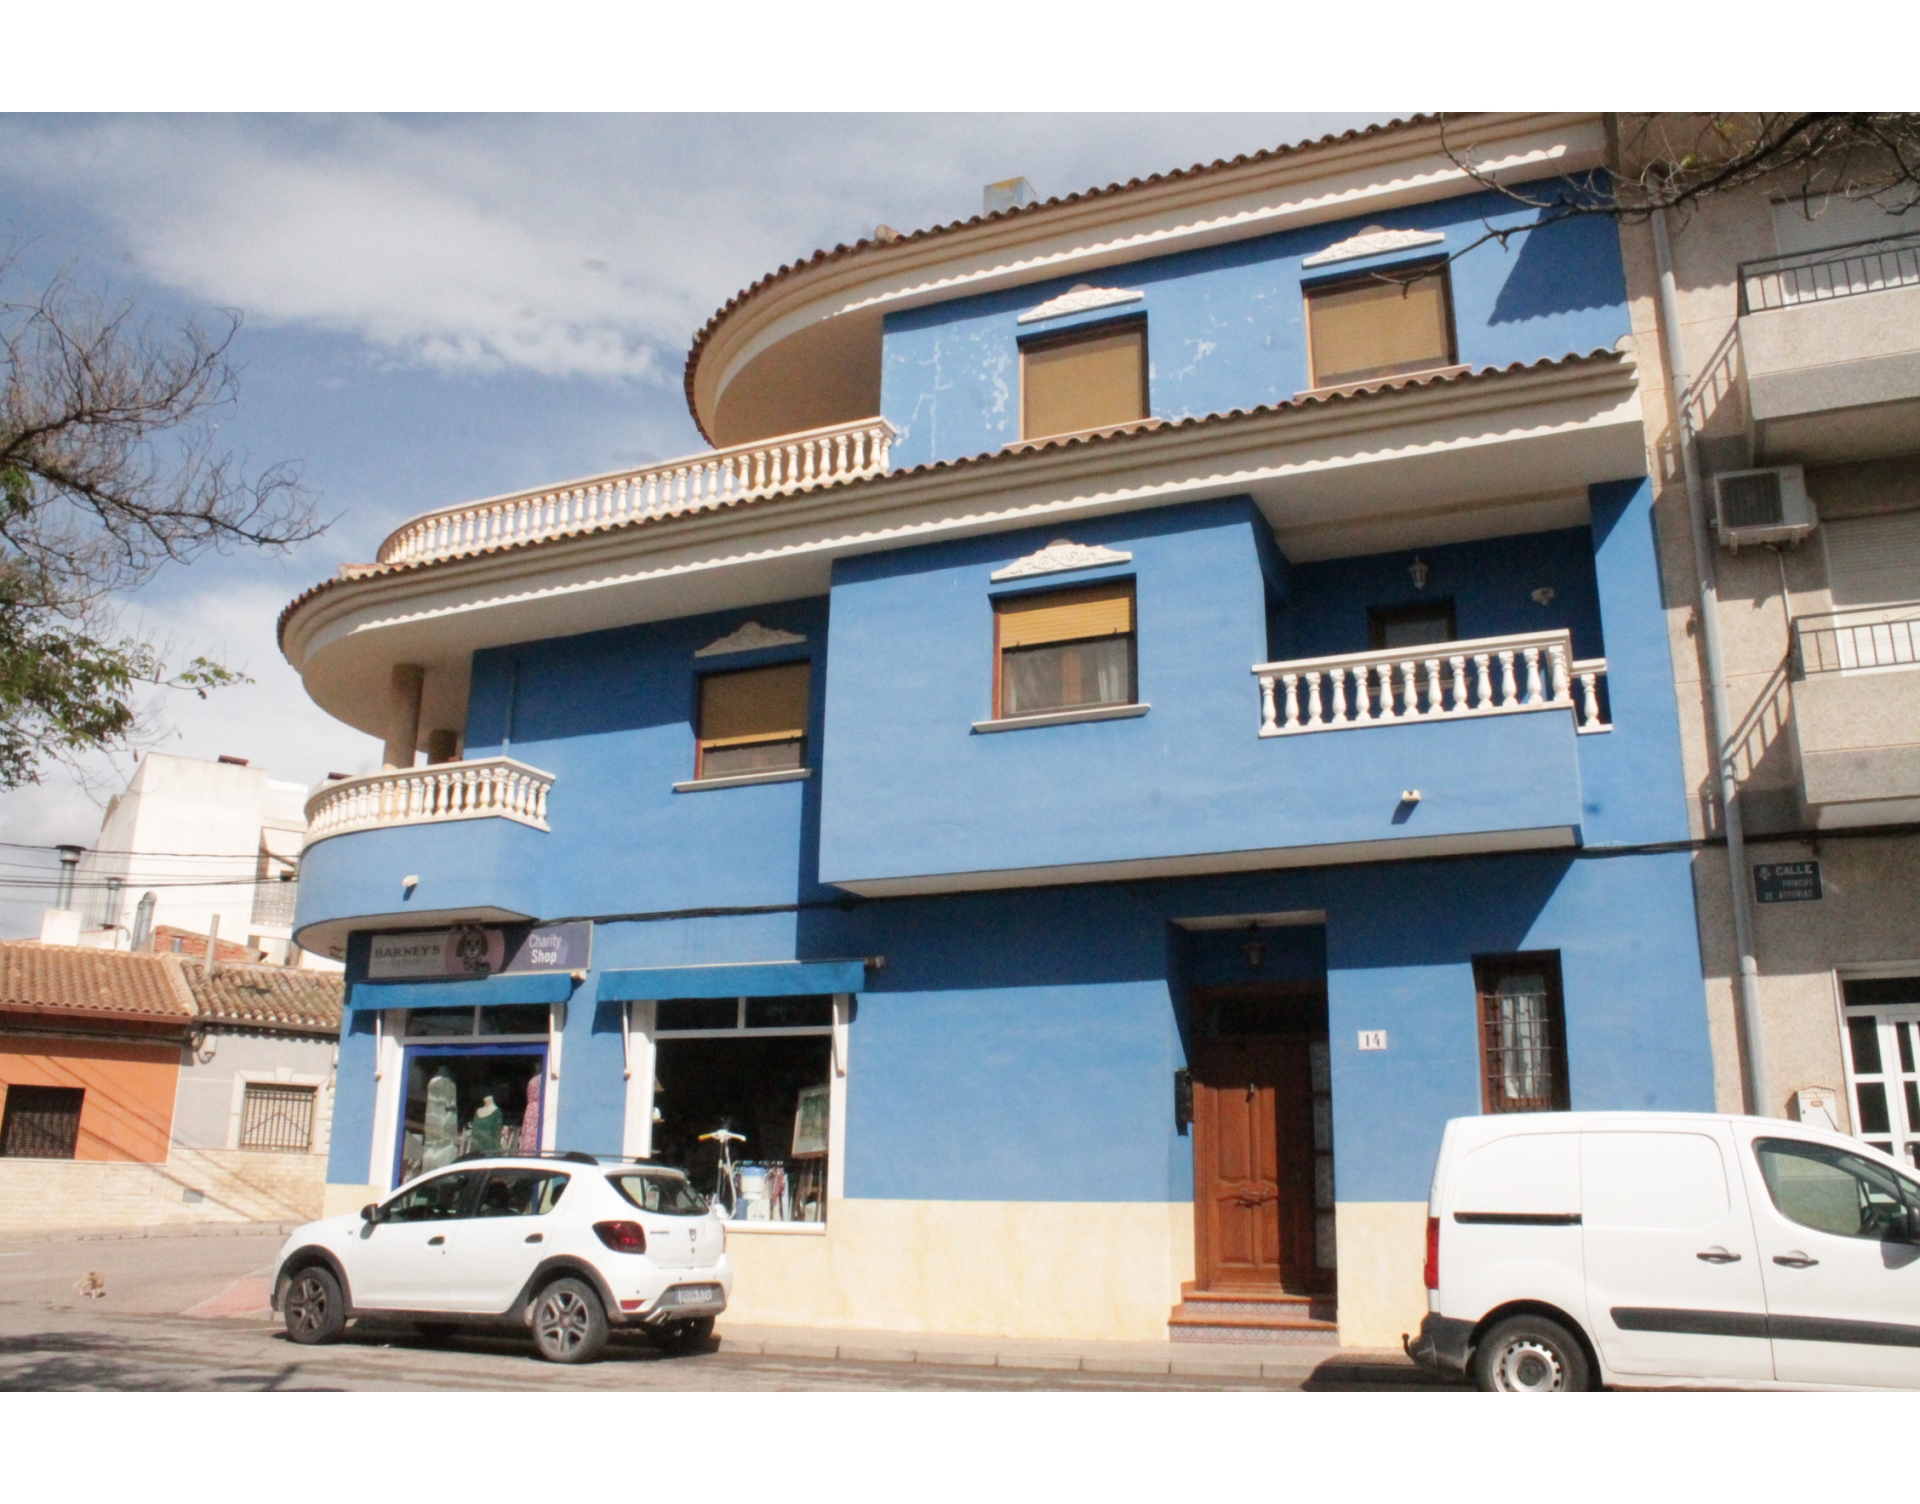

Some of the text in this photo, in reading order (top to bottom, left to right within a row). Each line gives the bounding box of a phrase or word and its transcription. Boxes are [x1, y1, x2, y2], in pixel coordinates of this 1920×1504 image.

[1775, 864, 1813, 875] CALLE
[1764, 892, 1773, 900] DE
[529, 934, 562, 950] Charity
[531, 950, 557, 965] Shop
[1365, 1033, 1380, 1047] 14
